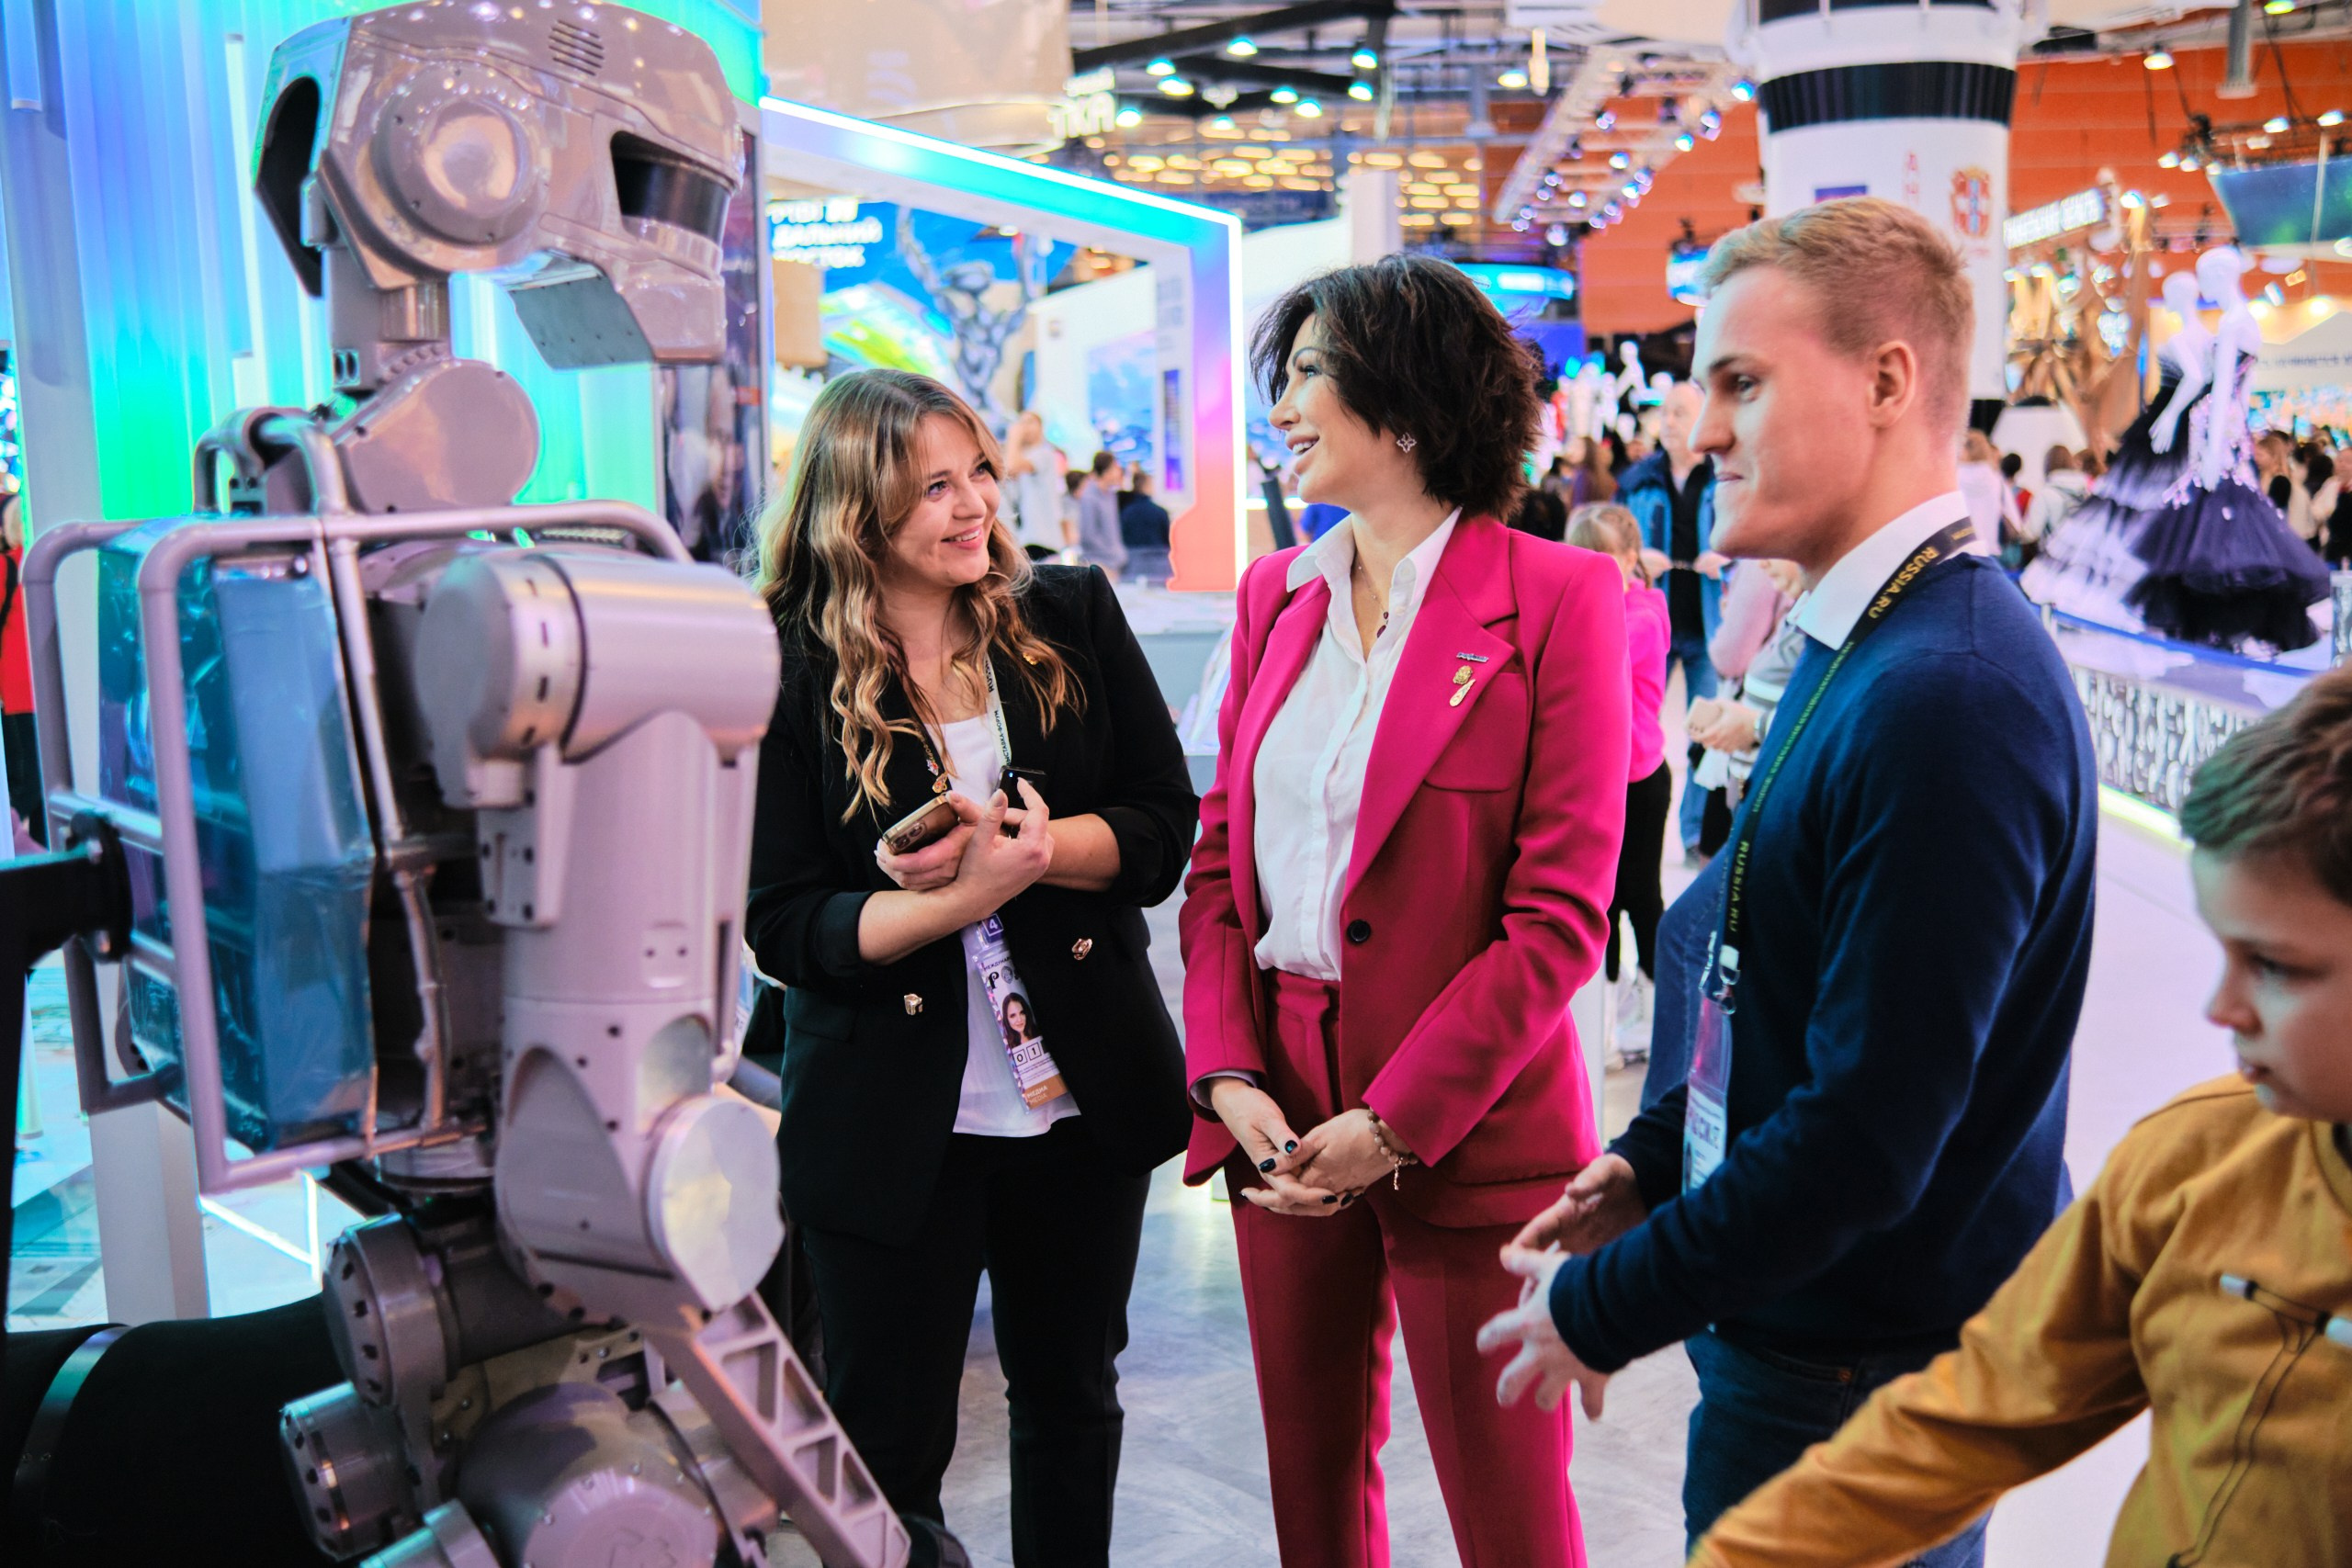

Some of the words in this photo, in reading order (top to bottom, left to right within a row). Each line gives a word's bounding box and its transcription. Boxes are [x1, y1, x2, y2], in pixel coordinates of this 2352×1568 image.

[1868, 547, 1939, 619] RUSSIA.RU
[989, 919, 999, 930] 4
[1027, 1085, 1048, 1099] МЕДИА
